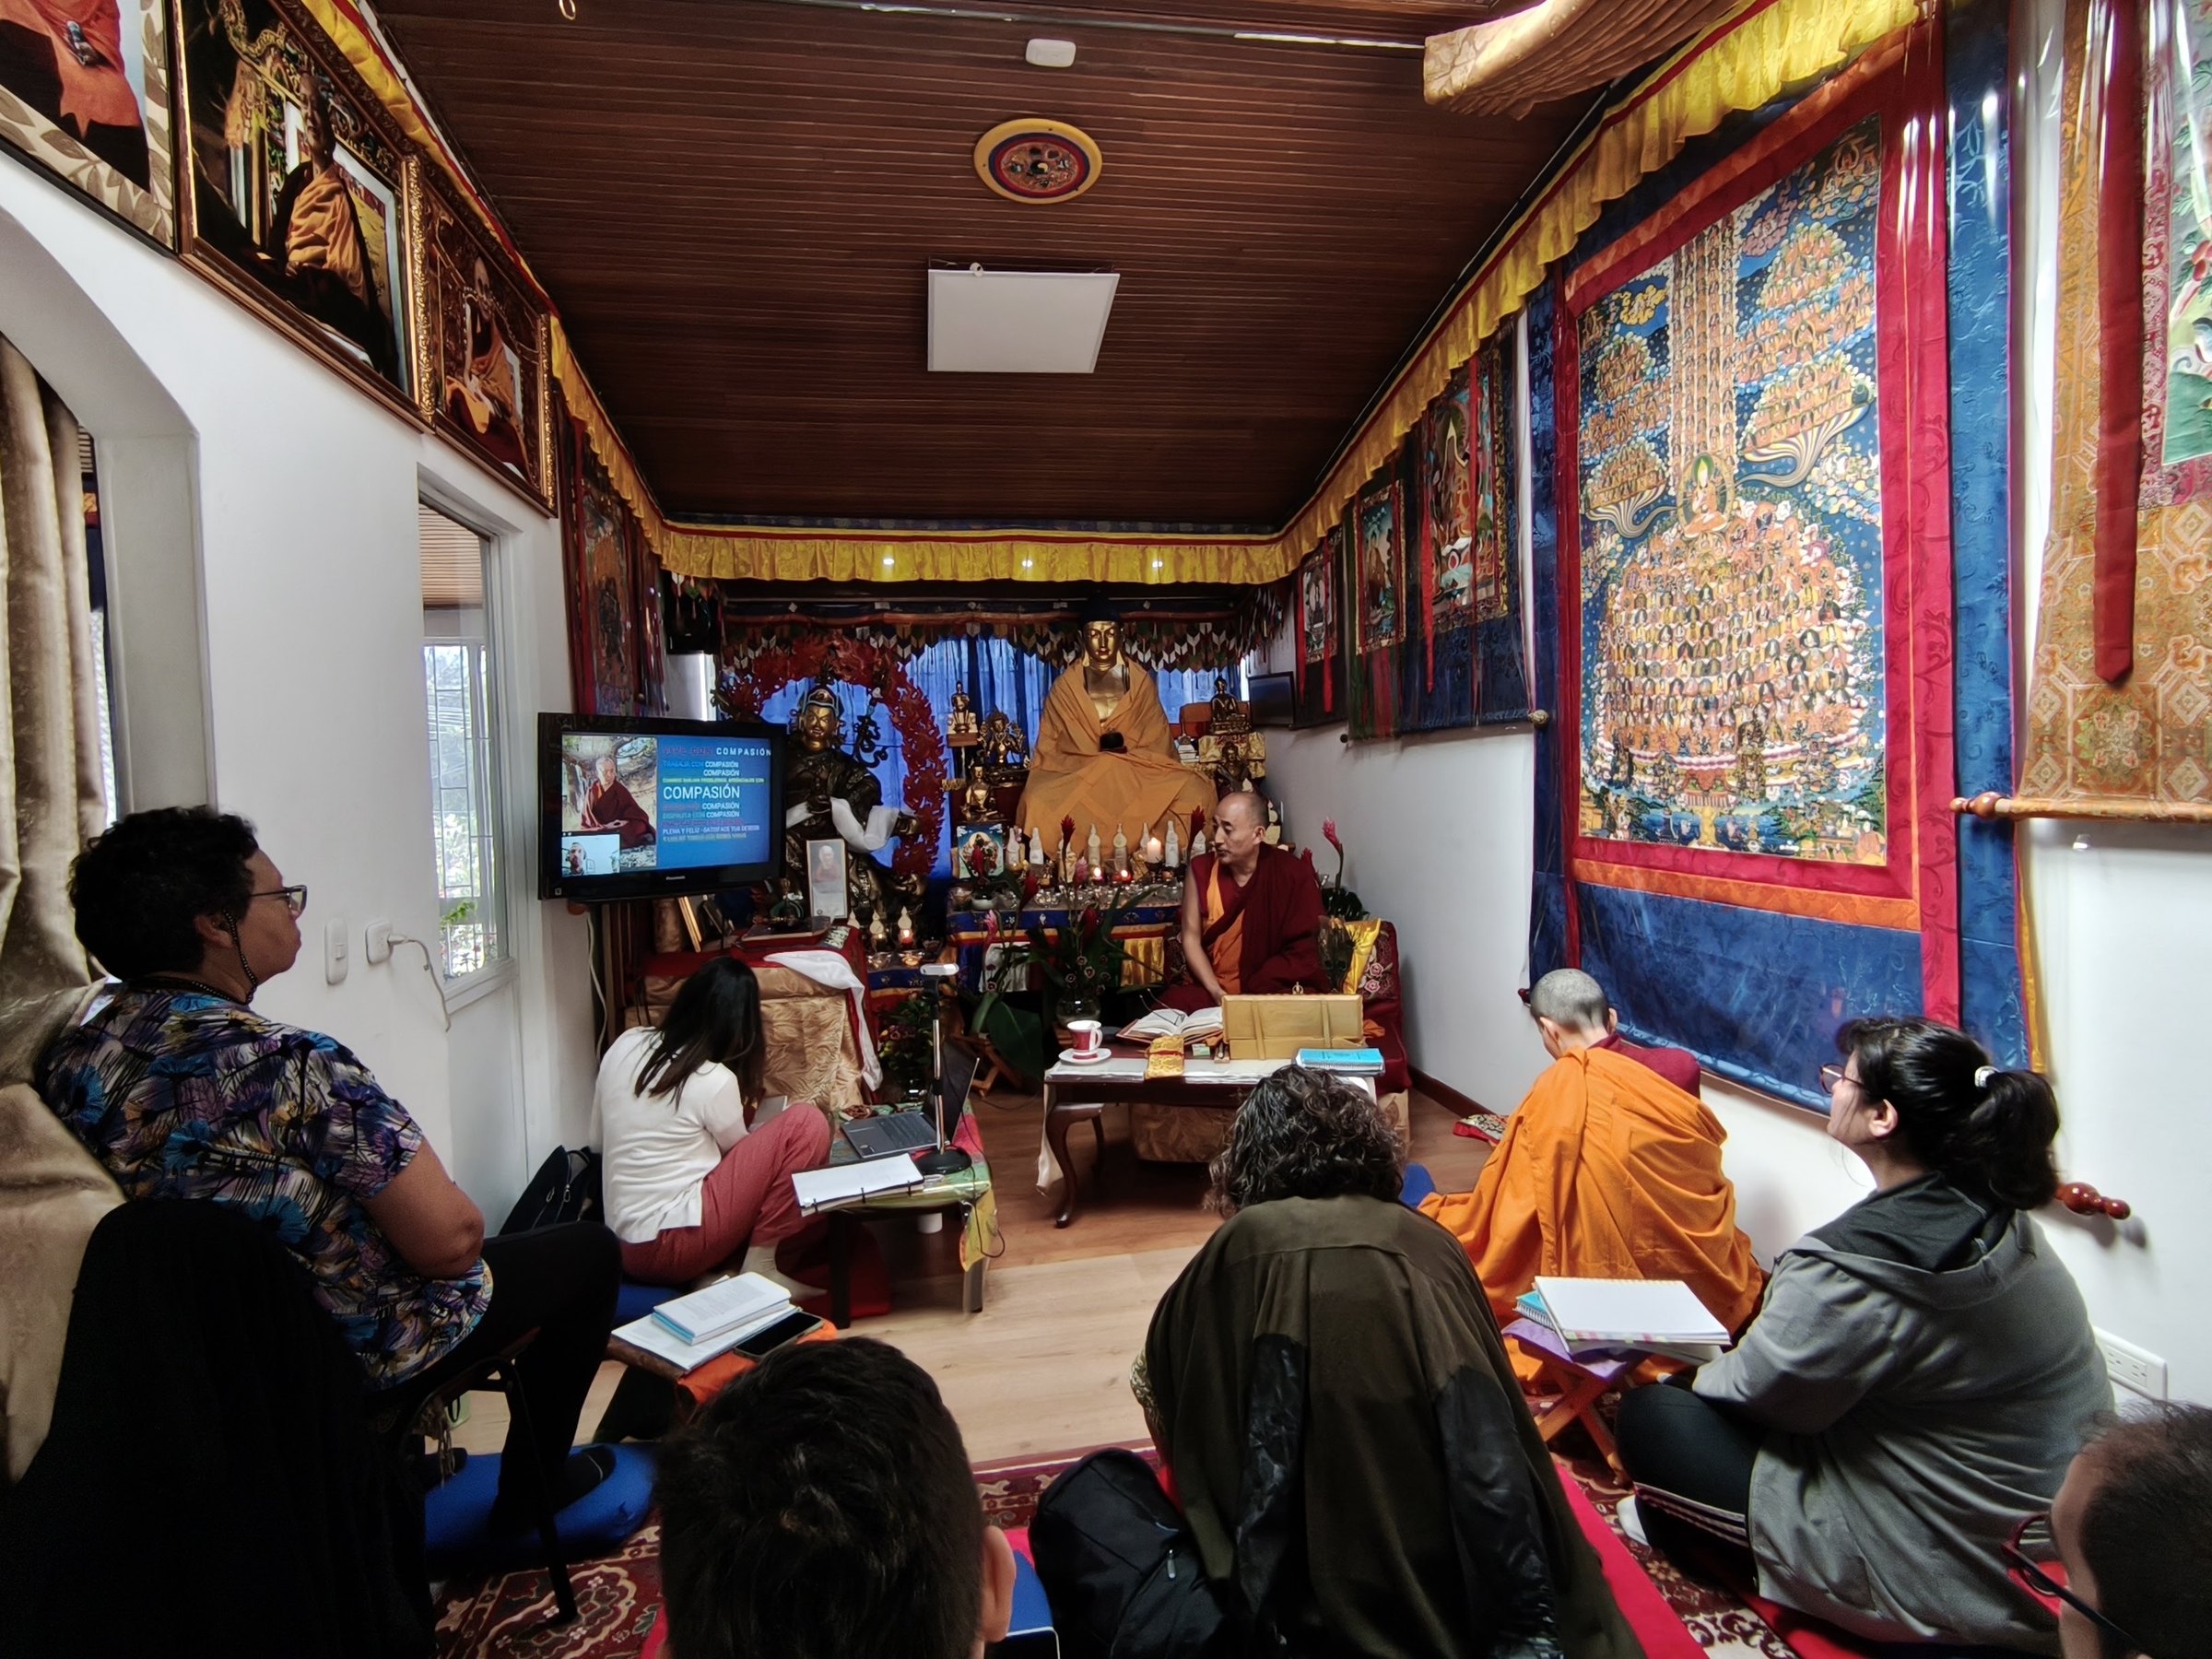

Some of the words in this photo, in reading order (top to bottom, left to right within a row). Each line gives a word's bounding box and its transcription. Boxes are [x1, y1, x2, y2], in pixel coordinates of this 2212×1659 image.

[715, 747, 771, 757] COMPASIÓN
[705, 759, 739, 768] COMPASIÓN
[703, 768, 740, 777] COMPASIÓN
[663, 783, 740, 800] COMPASIÓN
[701, 801, 740, 810] COMPASIÓN
[706, 810, 740, 818] COMPASIÓN
